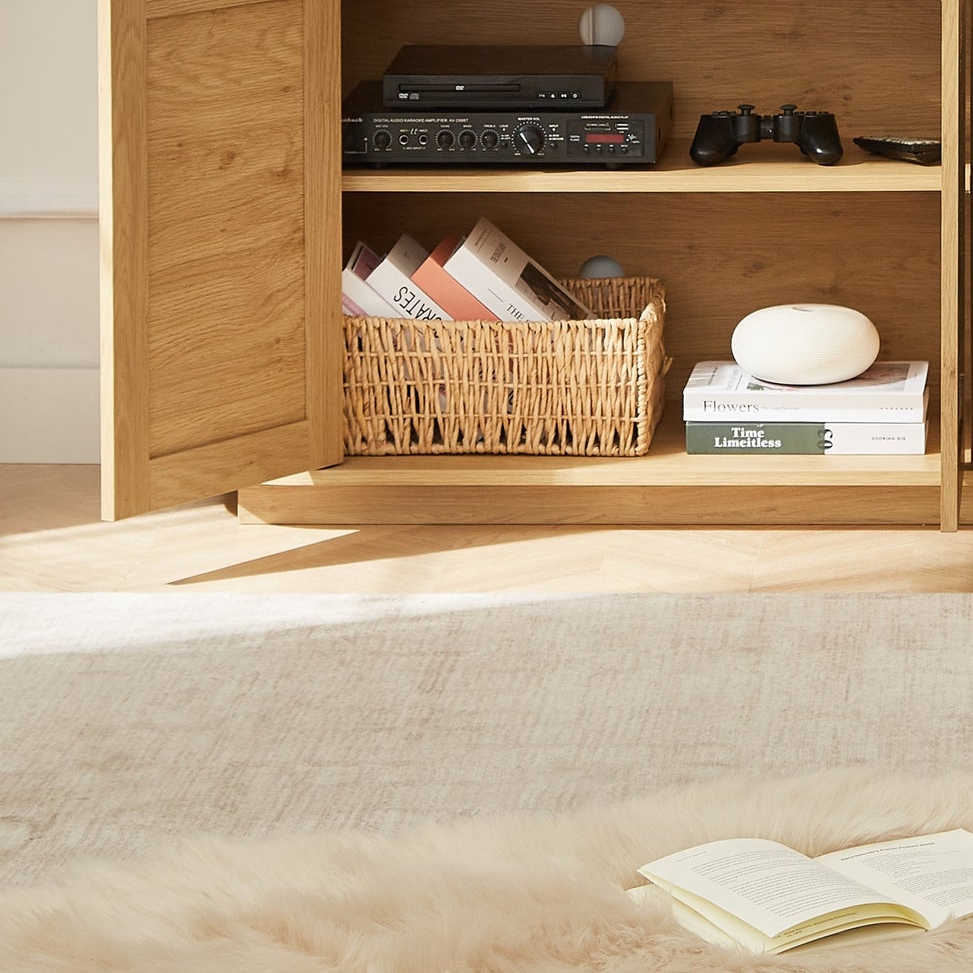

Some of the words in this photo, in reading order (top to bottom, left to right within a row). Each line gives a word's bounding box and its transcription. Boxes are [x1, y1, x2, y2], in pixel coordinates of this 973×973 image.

[393, 286, 442, 321] RATES
[703, 400, 760, 413] Flowers
[731, 427, 765, 438] Time
[714, 437, 782, 448] Limeitless
